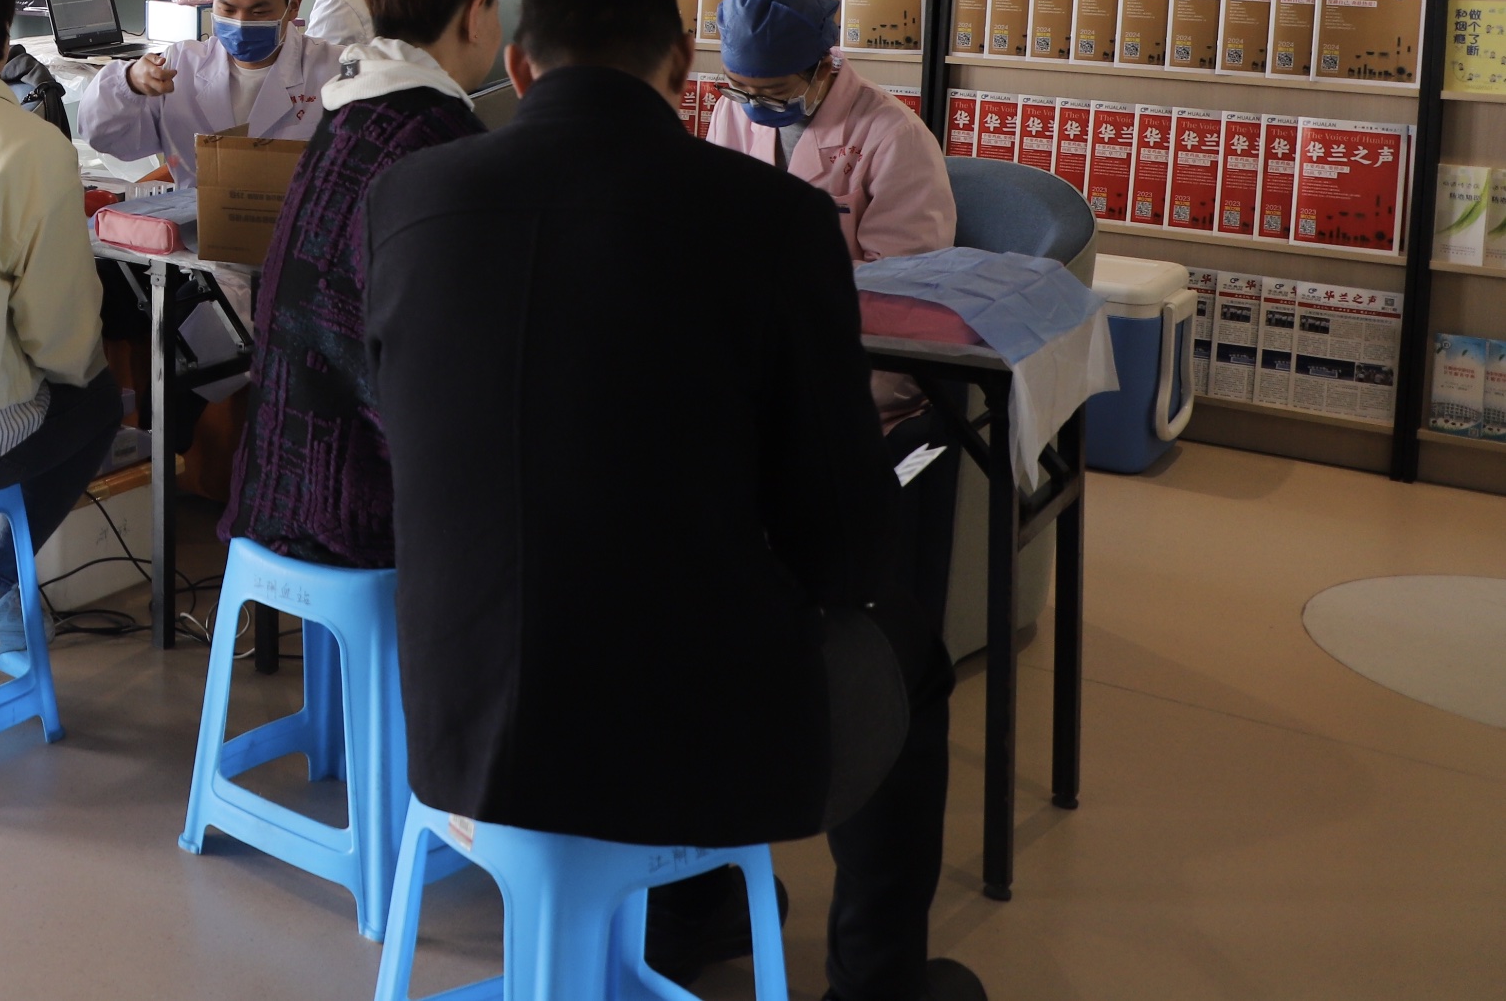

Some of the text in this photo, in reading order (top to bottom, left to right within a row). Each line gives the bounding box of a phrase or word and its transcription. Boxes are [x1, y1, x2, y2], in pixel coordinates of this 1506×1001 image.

[1466, 9, 1482, 57] 做个了断
[681, 91, 696, 107] 兰
[1179, 130, 1220, 150] 华兰
[1325, 132, 1350, 141] Voice
[1350, 133, 1361, 142] of
[1362, 135, 1395, 145] Hualan
[1305, 140, 1395, 168] 华兰之声
[1300, 207, 1316, 215] 2023
[1323, 289, 1377, 306] 华兰之声
